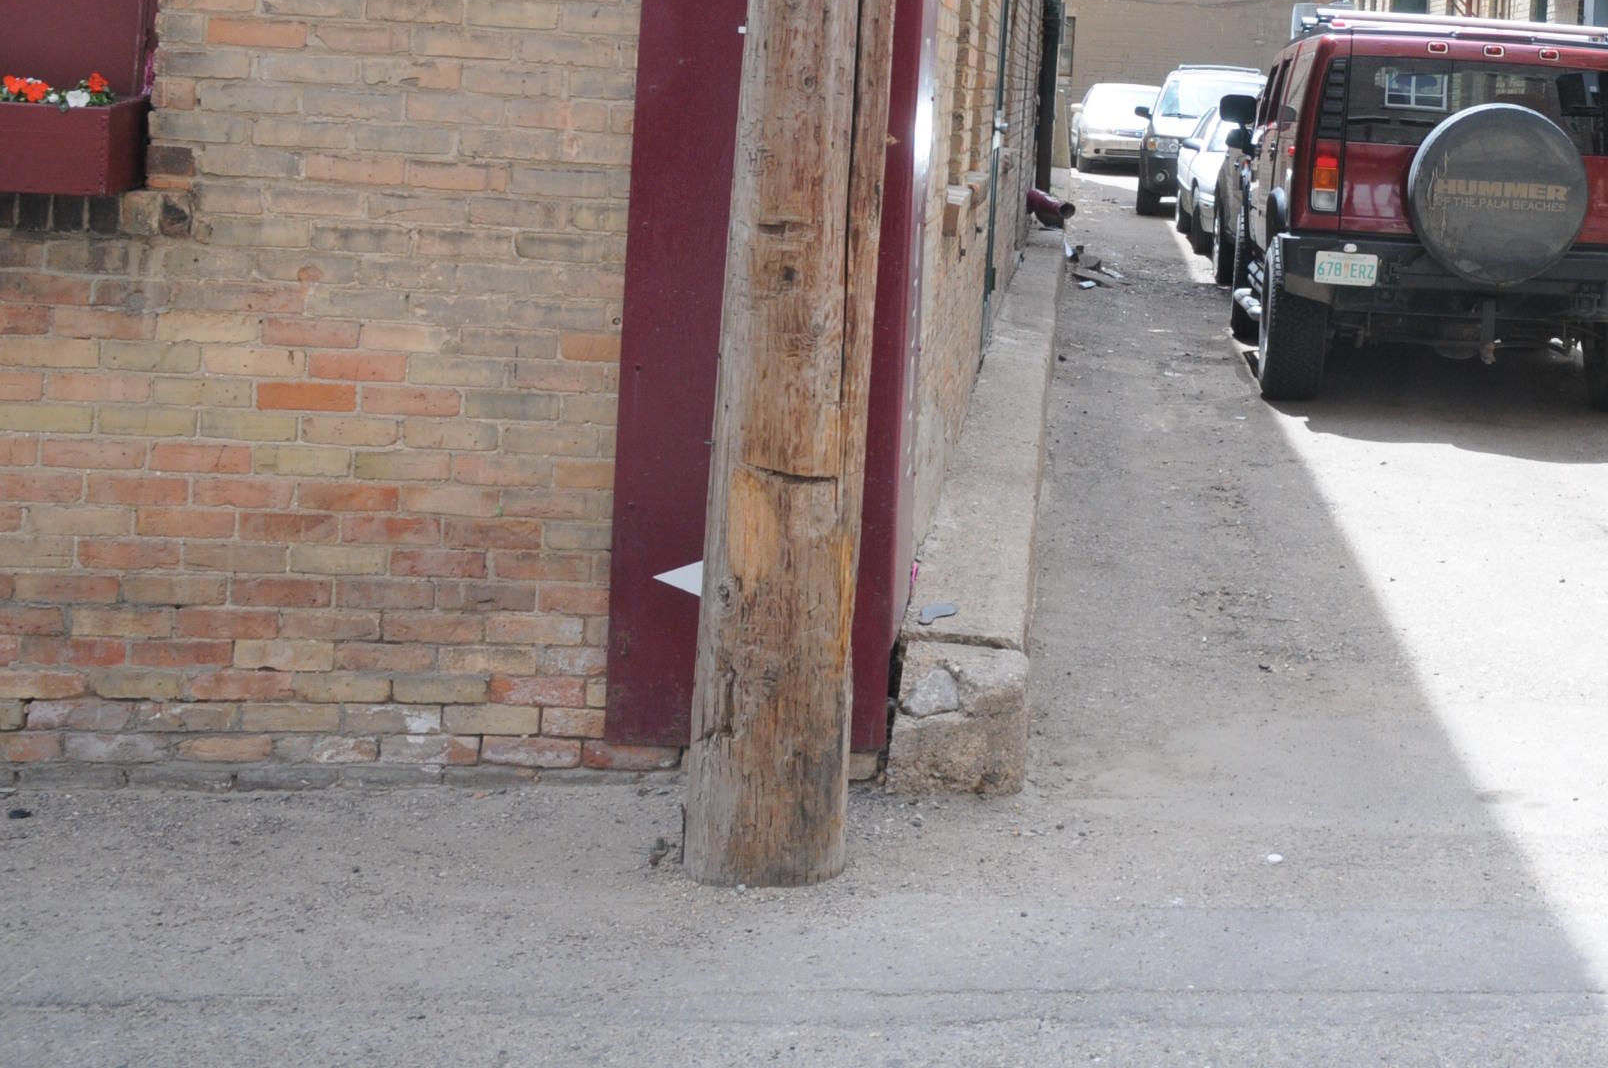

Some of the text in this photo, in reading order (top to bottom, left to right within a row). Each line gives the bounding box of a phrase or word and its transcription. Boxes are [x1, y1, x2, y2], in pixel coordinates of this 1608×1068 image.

[1435, 178, 1568, 202] HUMMER
[1433, 195, 1567, 213] OF THE PALM BEACHES
[1317, 260, 1376, 280] 678 ERZ
